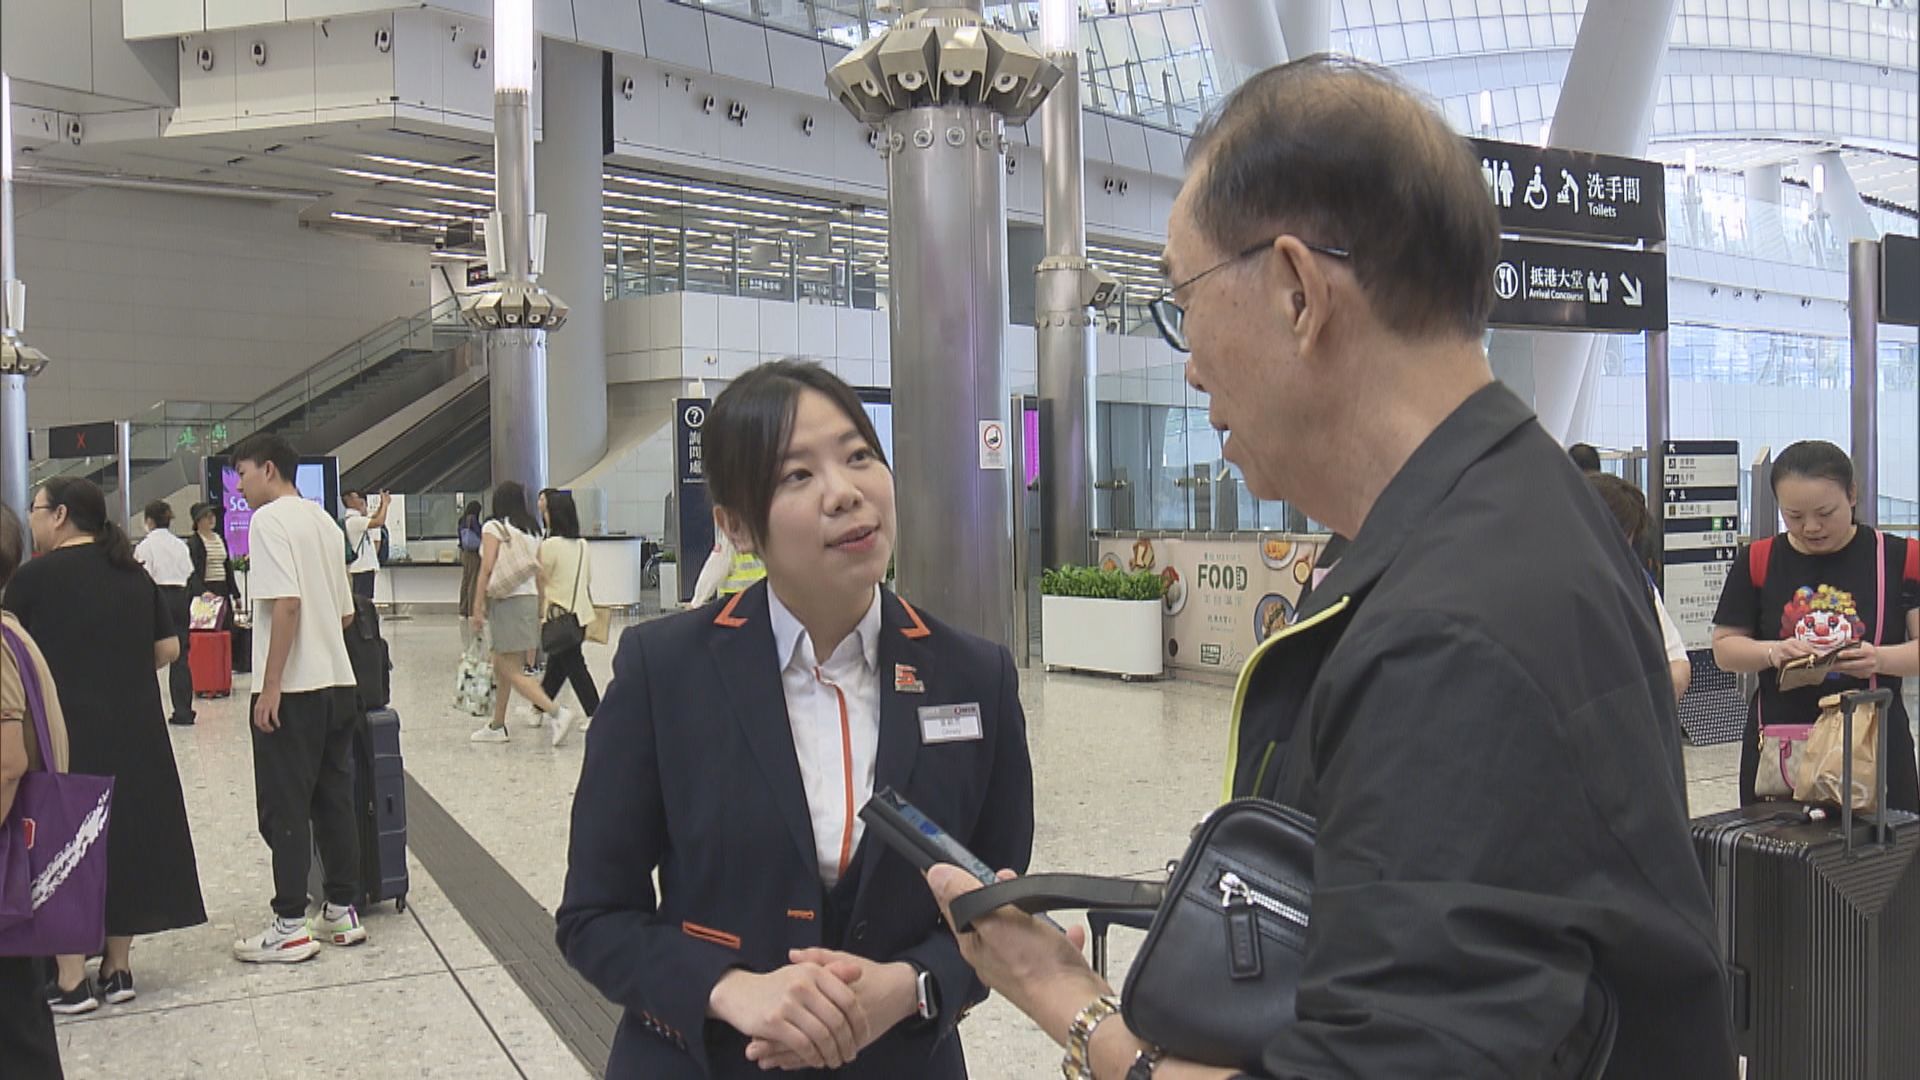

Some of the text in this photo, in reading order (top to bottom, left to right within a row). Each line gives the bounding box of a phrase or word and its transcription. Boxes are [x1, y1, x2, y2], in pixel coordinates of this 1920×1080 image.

[1587, 172, 1640, 203] 洗手間
[1587, 202, 1617, 218] Toilets
[1529, 266, 1584, 290] 抵港大堂
[1529, 288, 1584, 301] Arrival Concourse
[1198, 564, 1248, 591] FOOD
